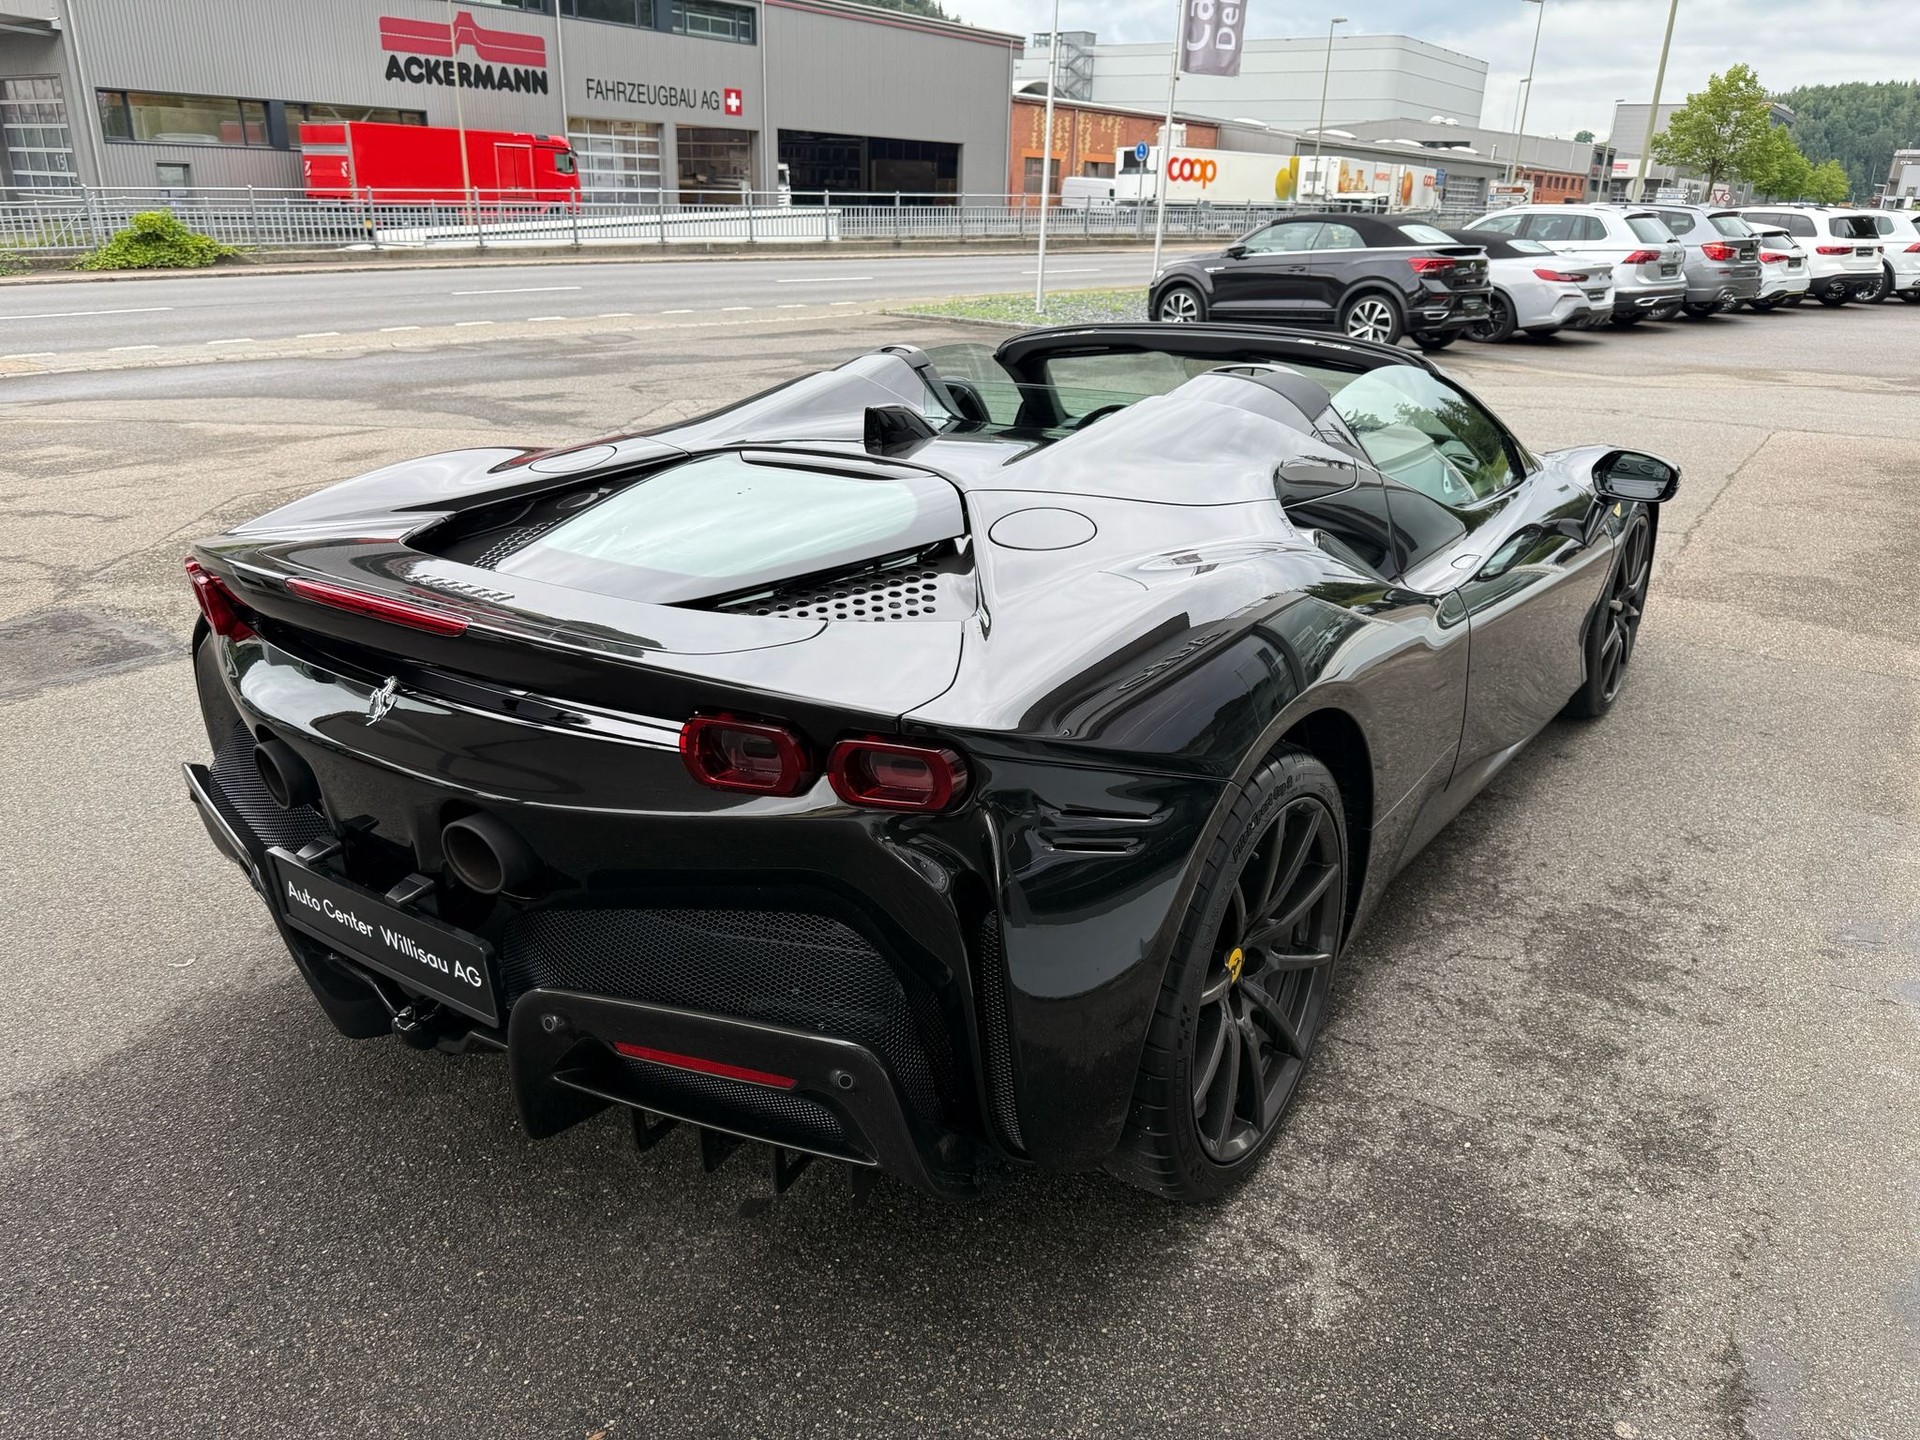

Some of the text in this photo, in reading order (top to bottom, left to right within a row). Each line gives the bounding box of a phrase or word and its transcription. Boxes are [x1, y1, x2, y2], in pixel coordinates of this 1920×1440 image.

[385, 54, 549, 95] ACKERMANN
[586, 78, 720, 111] FAHRZEUGBAU AG
[1168, 157, 1217, 189] coop
[288, 880, 482, 988] Auto Center Willisau AG
